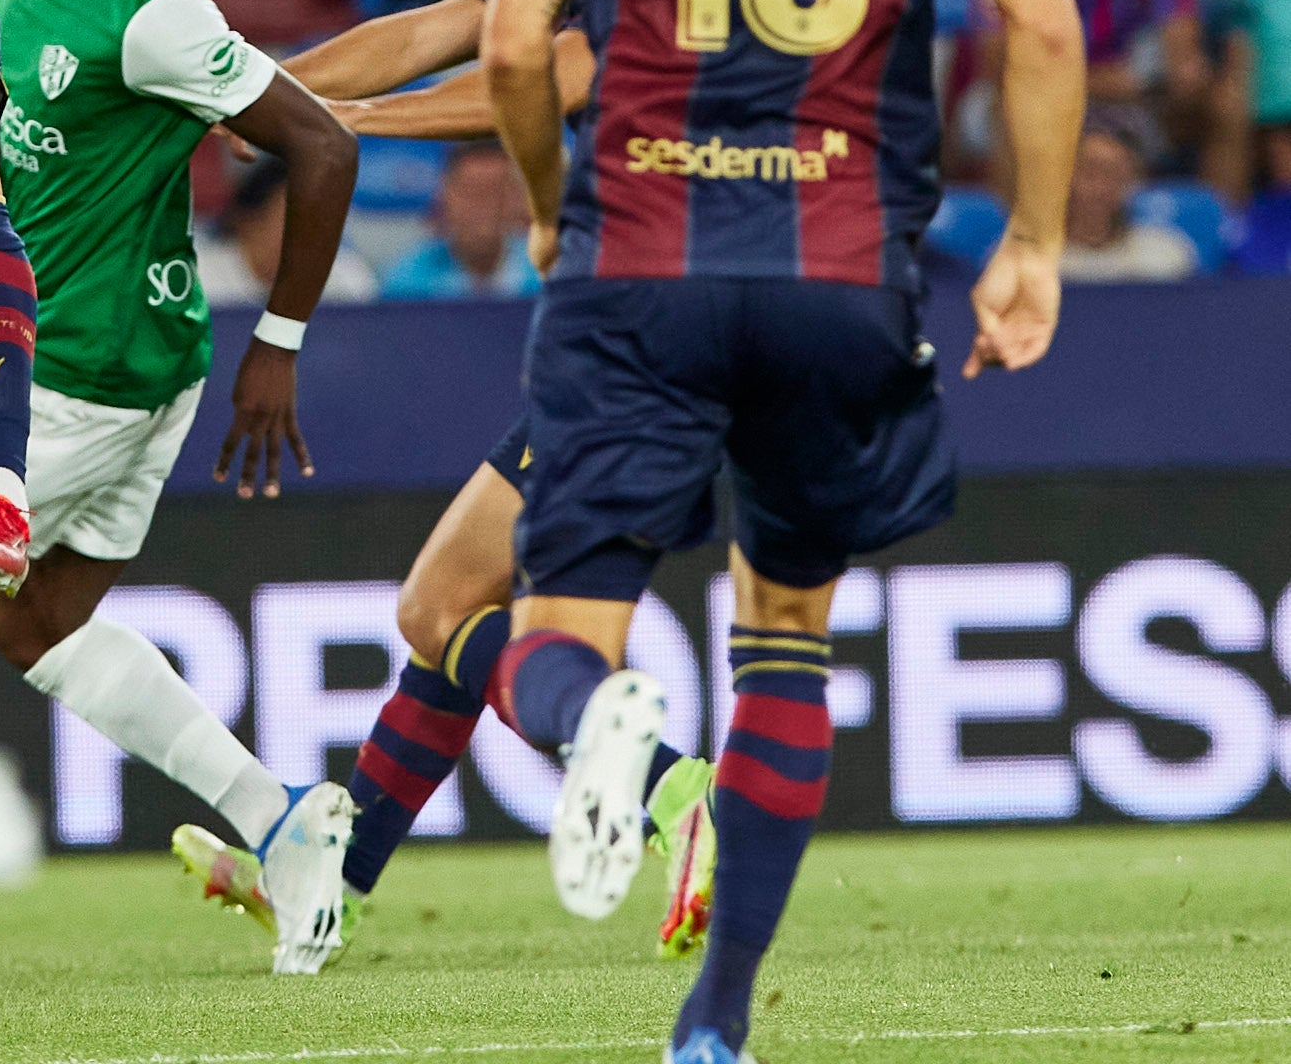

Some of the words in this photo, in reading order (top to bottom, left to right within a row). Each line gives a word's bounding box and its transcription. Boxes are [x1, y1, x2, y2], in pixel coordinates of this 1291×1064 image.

[625, 135, 829, 182] sesderma
[146, 259, 196, 306] SO
[52, 553, 1291, 846] PROES
